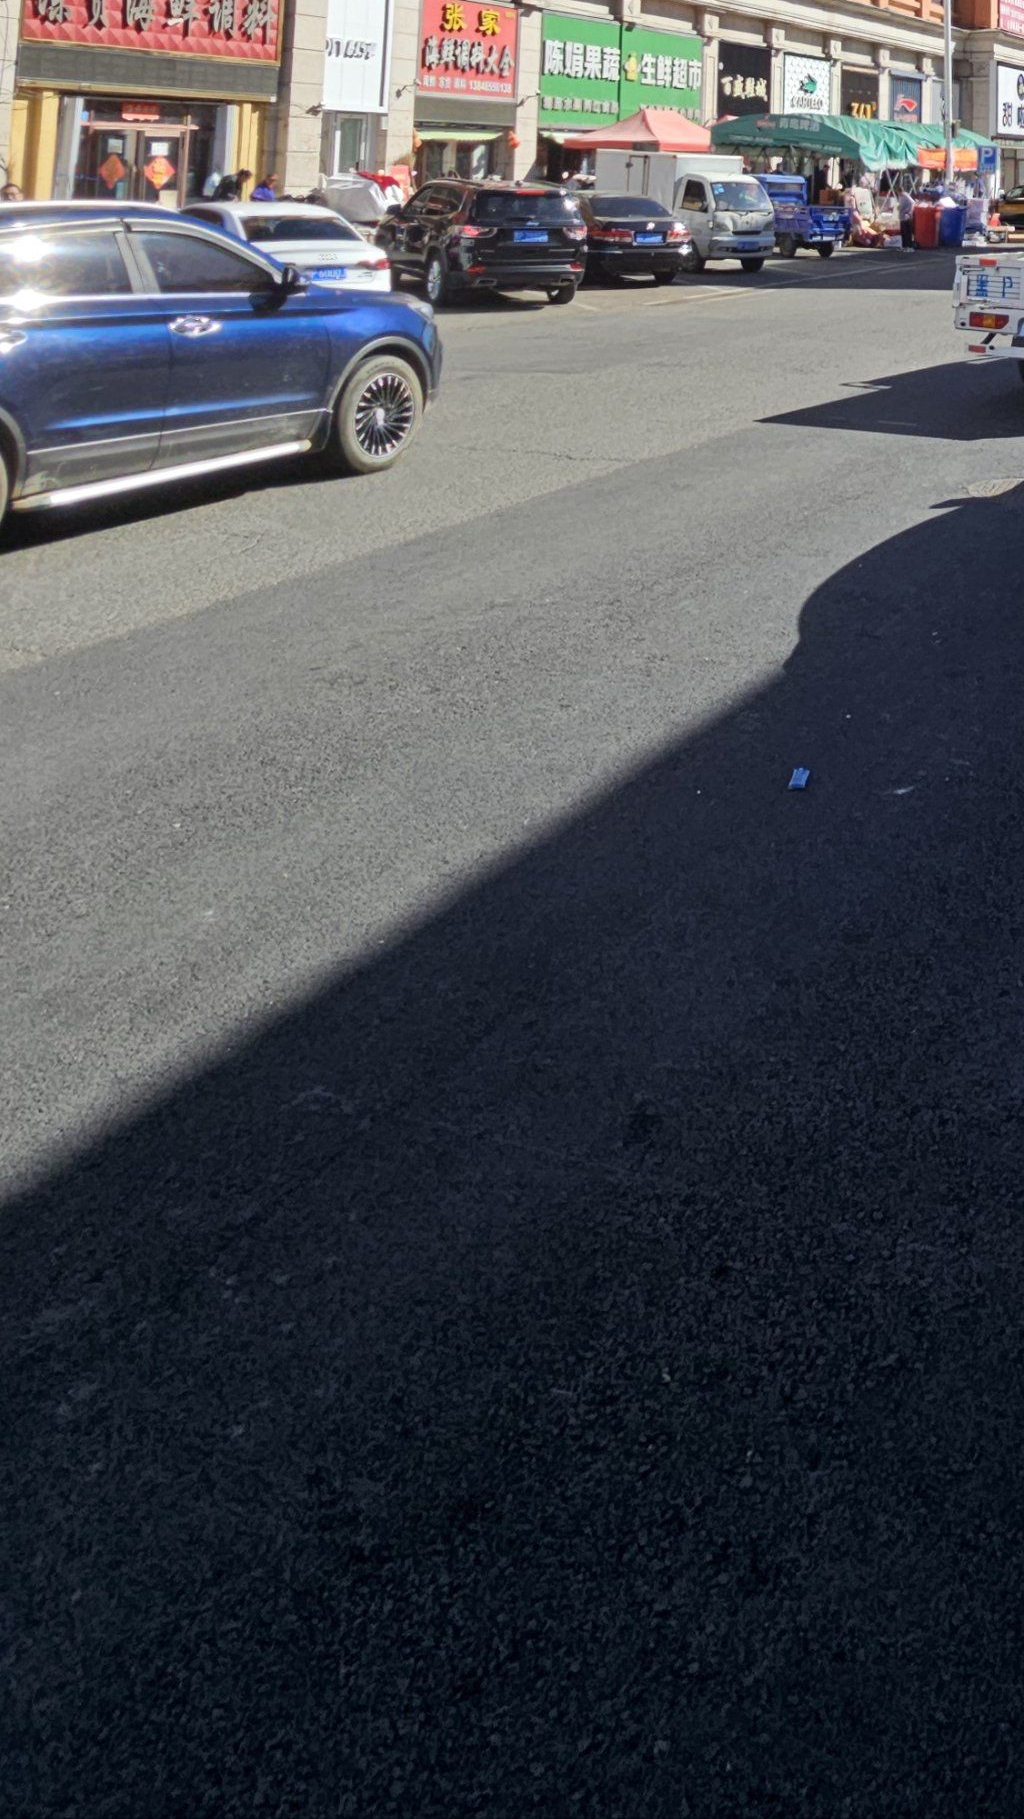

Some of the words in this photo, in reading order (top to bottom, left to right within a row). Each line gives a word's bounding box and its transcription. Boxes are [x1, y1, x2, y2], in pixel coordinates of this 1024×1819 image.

[442, 3, 501, 36] 张家
[424, 36, 515, 76] 海鲜调料大全
[543, 39, 620, 82] 陈娟果蔬
[641, 53, 702, 91] 生鲜超市
